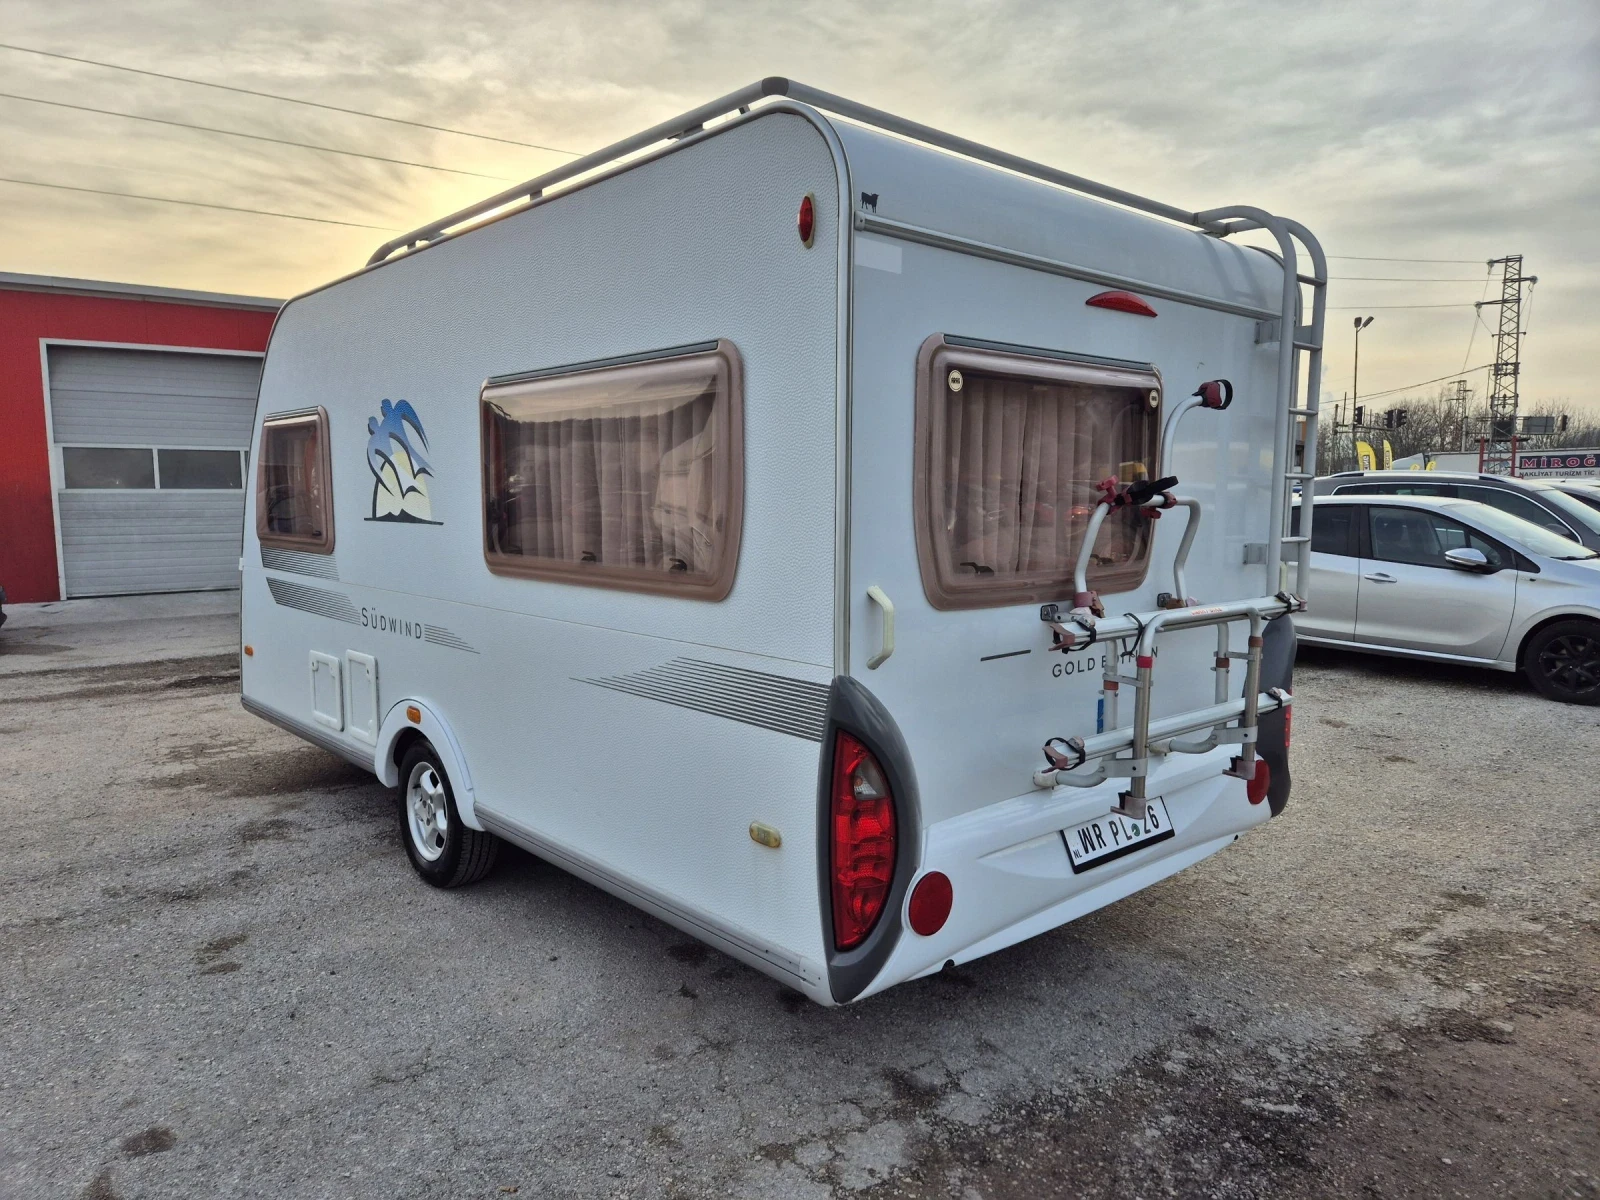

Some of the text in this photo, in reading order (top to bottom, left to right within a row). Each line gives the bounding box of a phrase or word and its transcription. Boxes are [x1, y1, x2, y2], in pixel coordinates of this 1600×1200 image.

[361, 607, 422, 639] SÜDWIND
[1052, 657, 1096, 678] GOLD
[1077, 823, 1107, 855] WR
[1108, 817, 1133, 846] PL
[1072, 849, 1083, 860] NL
